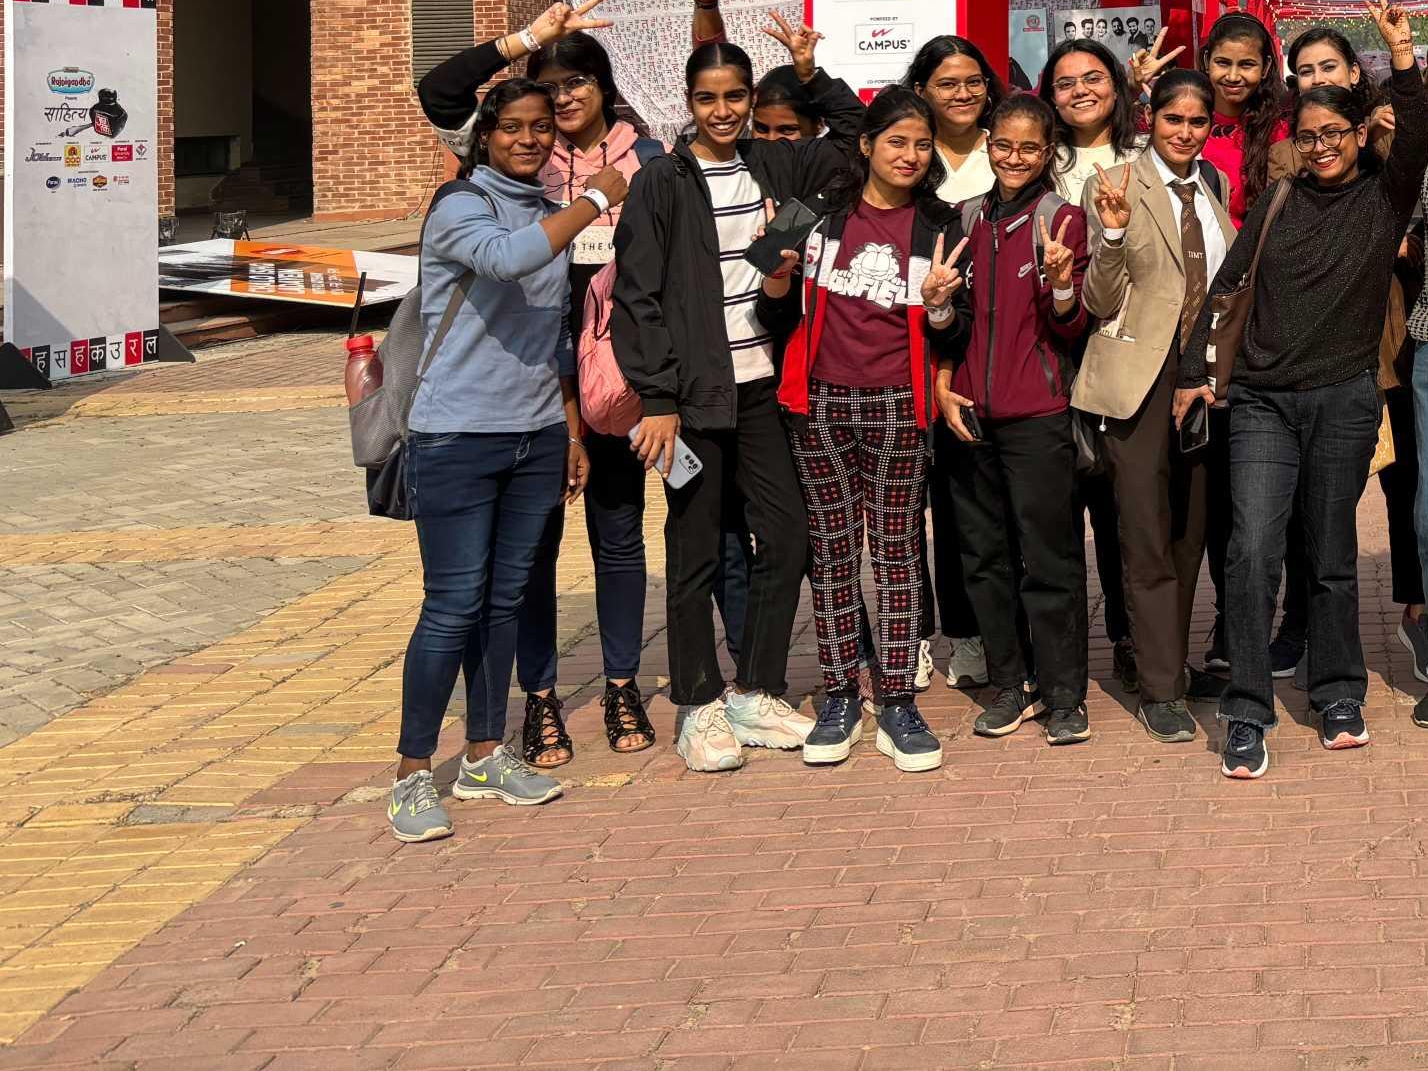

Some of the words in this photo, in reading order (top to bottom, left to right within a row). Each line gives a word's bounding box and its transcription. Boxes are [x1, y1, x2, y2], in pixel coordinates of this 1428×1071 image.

[858, 39, 907, 51] CAMPUS
[44, 103, 89, 122] साहित्य
[583, 242, 603, 250] THE
